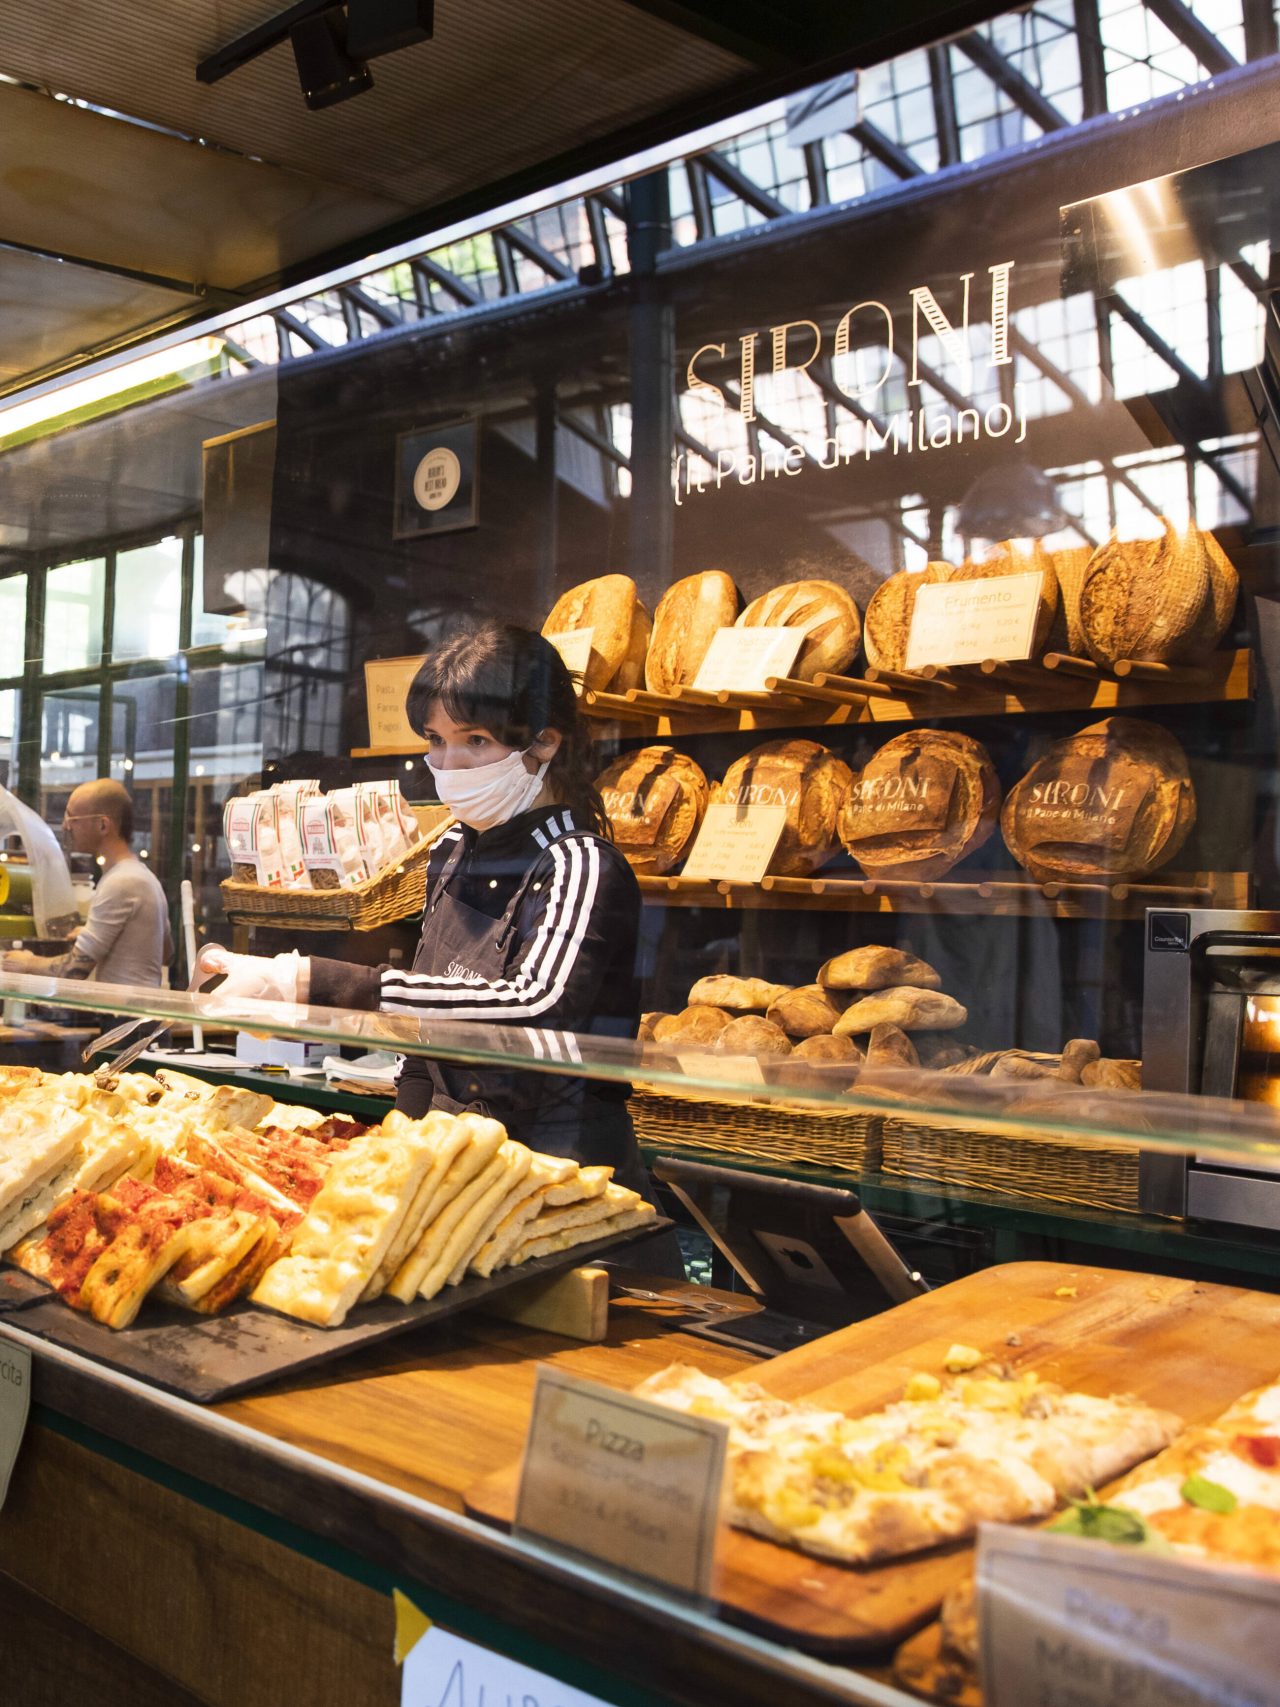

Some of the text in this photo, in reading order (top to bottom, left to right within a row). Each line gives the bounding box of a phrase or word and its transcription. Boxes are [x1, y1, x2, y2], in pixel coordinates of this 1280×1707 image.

[685, 260, 1015, 428] SIRONI
[716, 445, 805, 488] Pane
[818, 433, 850, 469] di
[944, 591, 1012, 608] Frumento
[725, 784, 799, 807] SIRONI
[850, 776, 932, 801] SIRONI
[1028, 779, 1126, 811] SIRONI
[887, 800, 925, 812] Milano
[1073, 809, 1117, 825] Milano
[585, 1417, 646, 1462] Pizza
